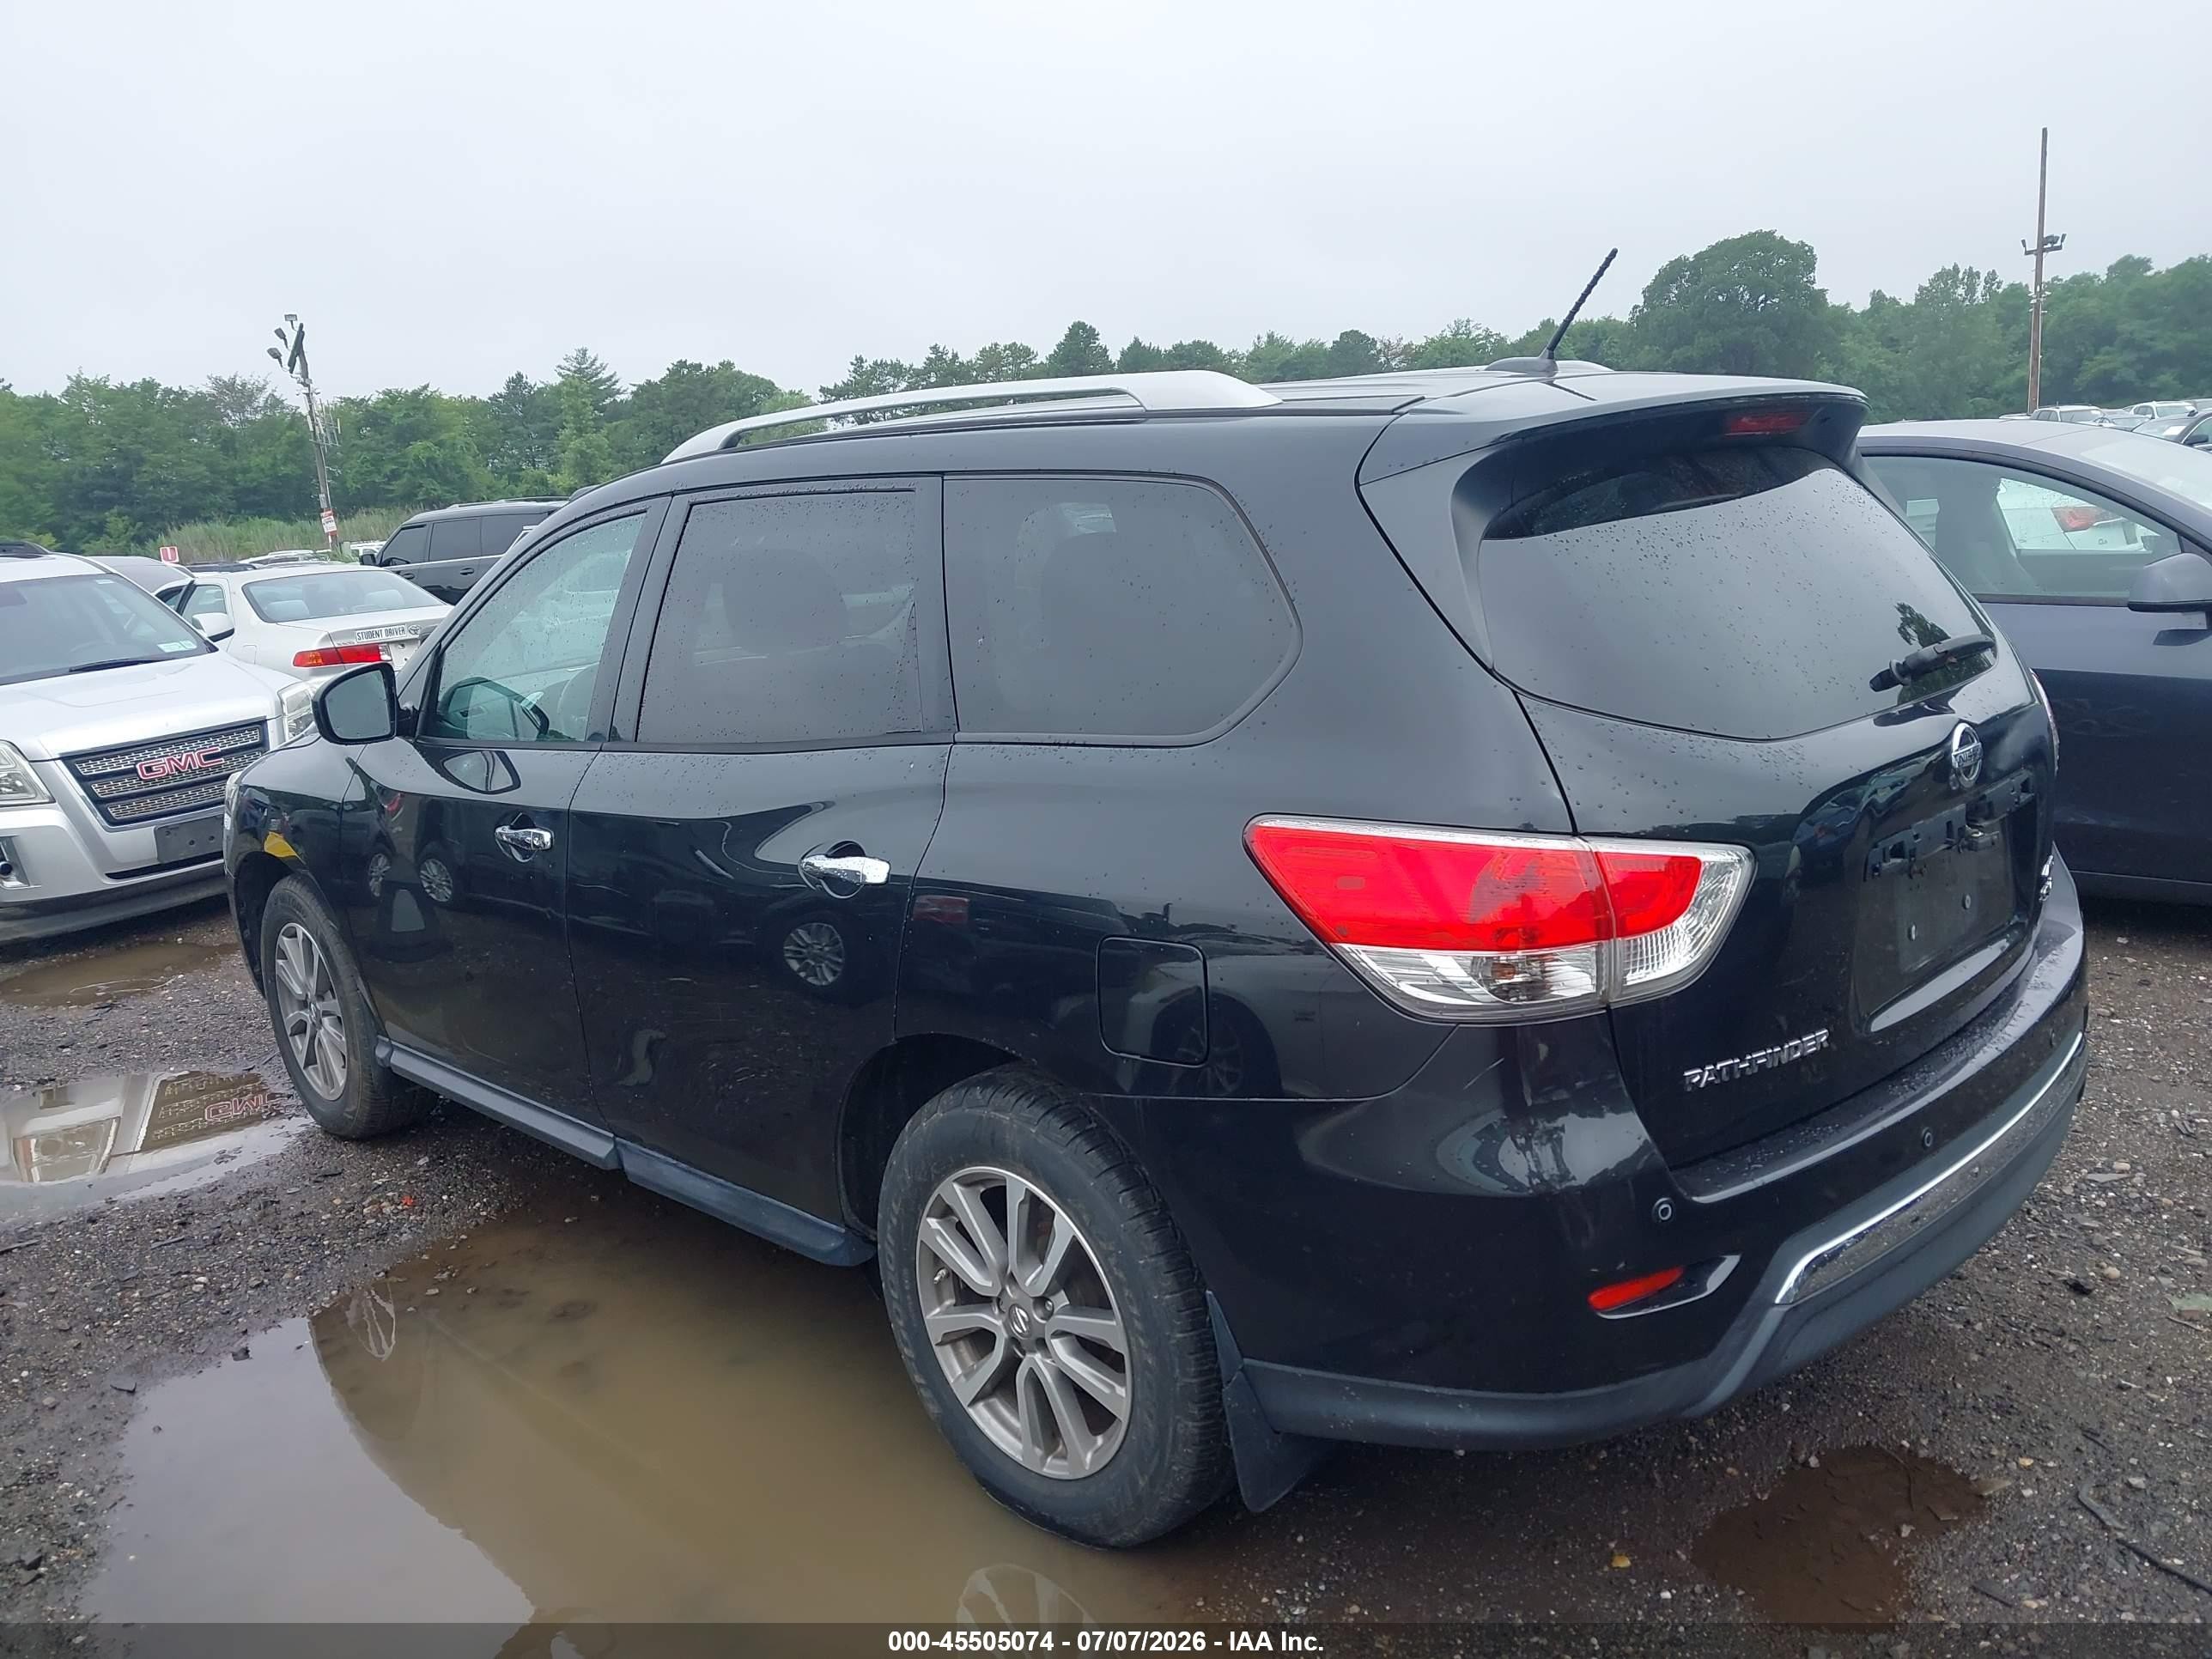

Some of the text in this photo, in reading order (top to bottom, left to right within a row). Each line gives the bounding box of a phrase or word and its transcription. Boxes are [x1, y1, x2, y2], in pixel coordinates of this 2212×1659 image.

[356, 627, 405, 641] STUDENT DRIVER
[137, 746, 225, 780] GMC
[1682, 1028, 1829, 1091] PATHFINDER
